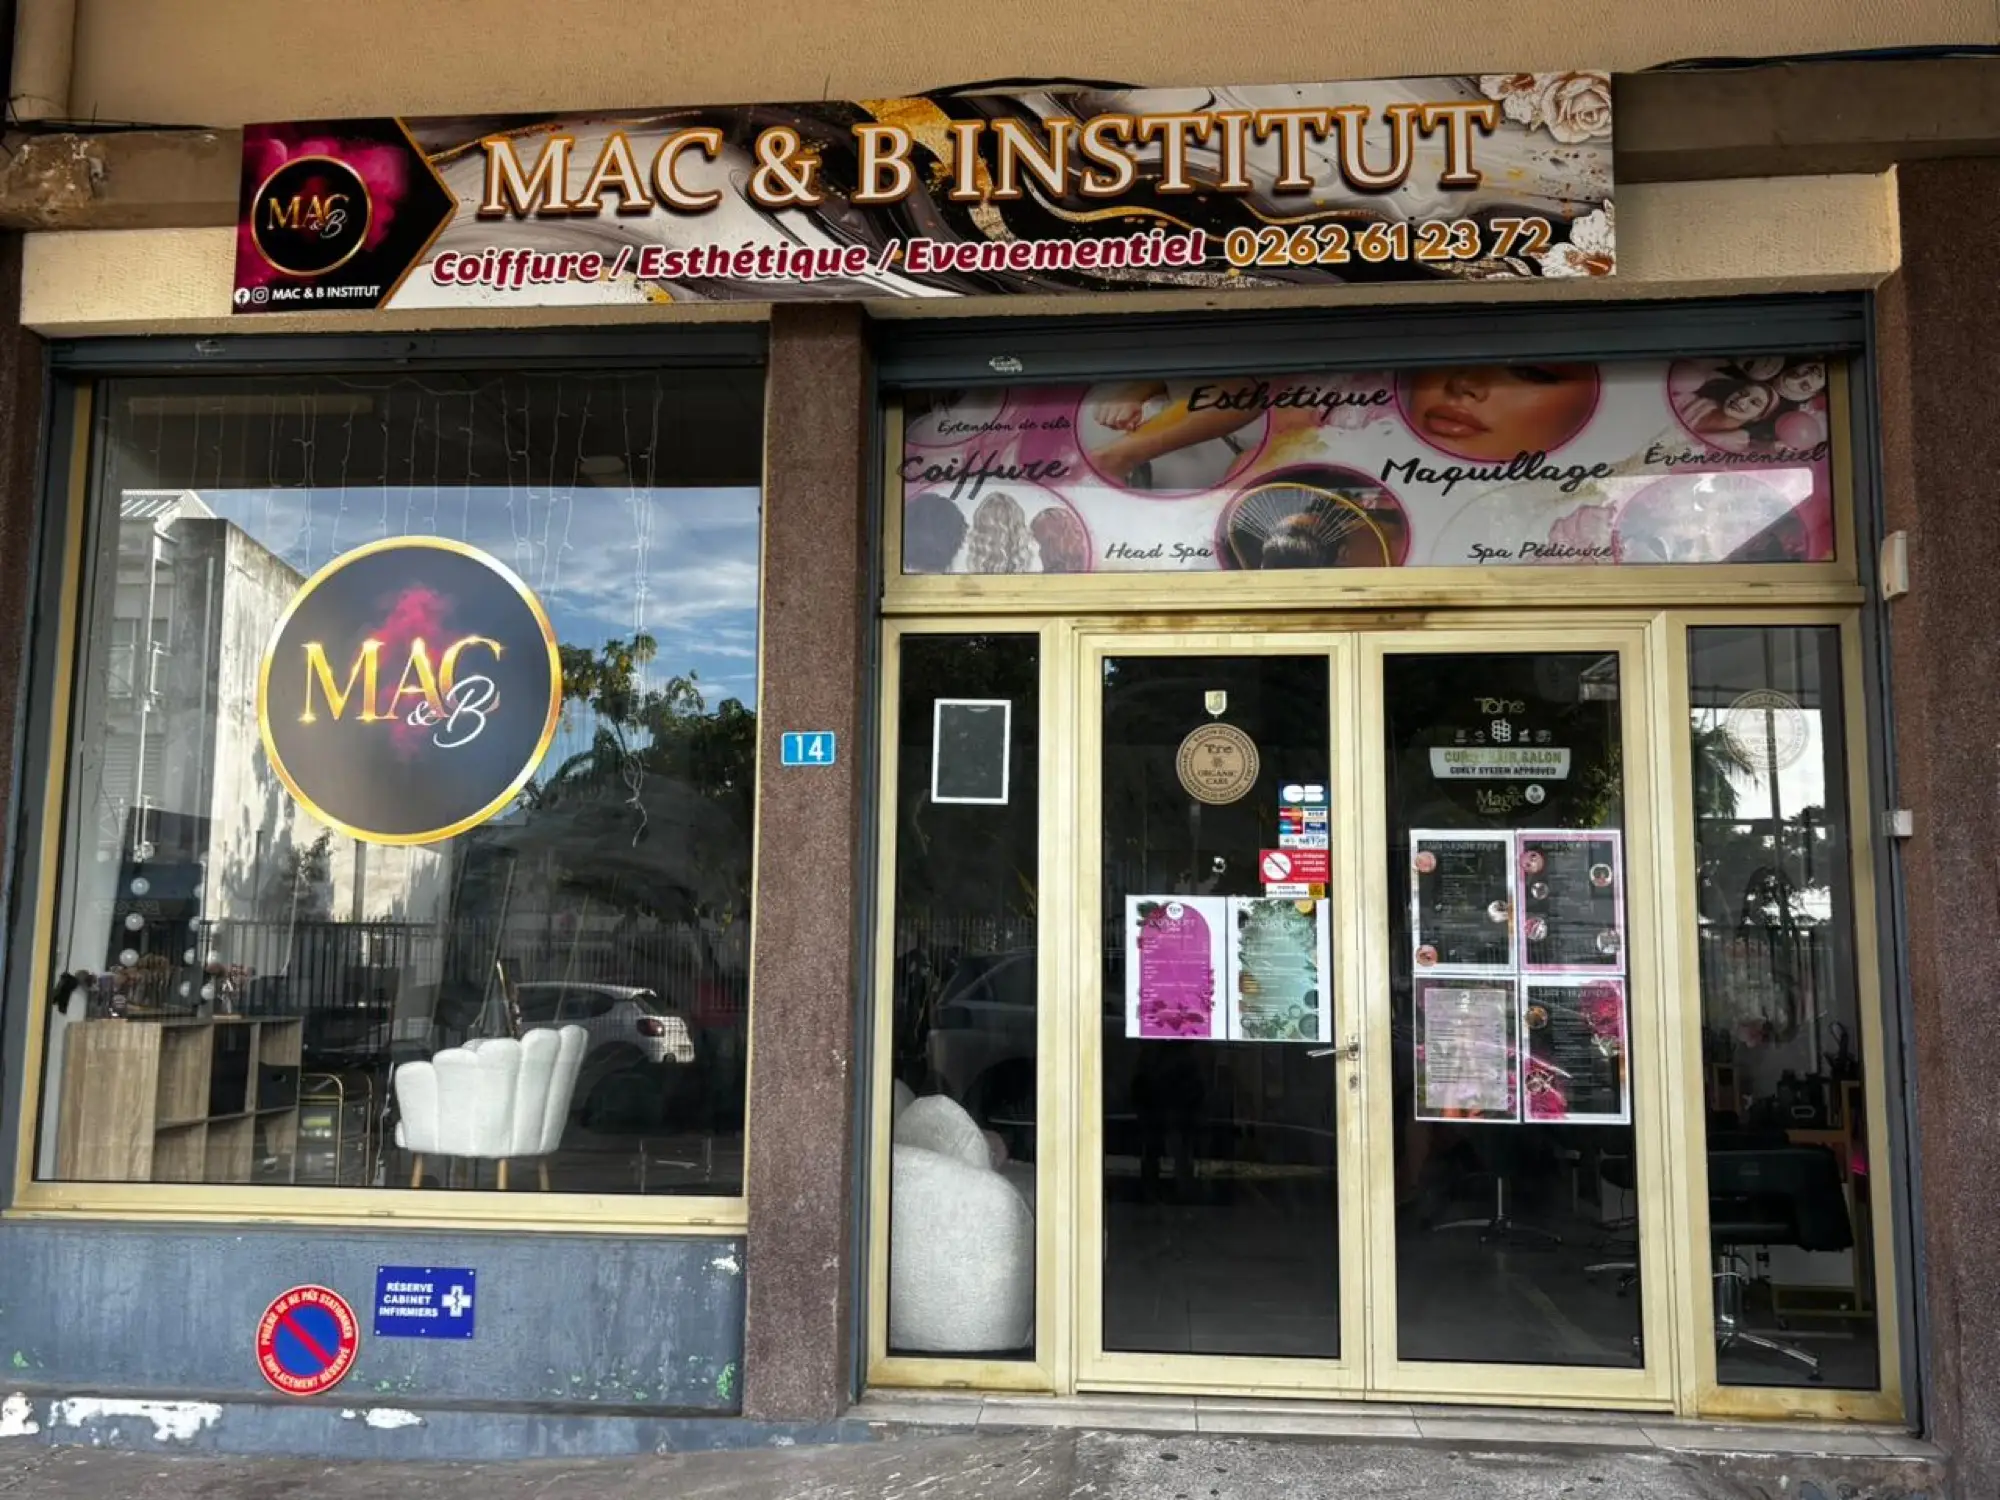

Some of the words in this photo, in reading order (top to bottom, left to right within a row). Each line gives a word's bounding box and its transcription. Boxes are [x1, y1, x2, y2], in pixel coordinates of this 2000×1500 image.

[476, 127, 723, 216] MAC
[750, 125, 821, 209] &
[852, 121, 914, 203] B
[947, 99, 1499, 199] INSTITUT
[267, 194, 349, 230] MAC
[320, 208, 347, 239] B
[433, 245, 600, 290] Coiffure
[638, 239, 866, 286] Esthétique
[905, 228, 1205, 272] Evenementiel
[1225, 223, 1350, 266] 0262
[1358, 223, 1409, 261] 61
[1414, 220, 1480, 259] 23
[1491, 217, 1551, 257] 72
[272, 288, 301, 300] MAC
[303, 288, 314, 299] &
[316, 287, 325, 298] B
[327, 285, 380, 297] INSTITUT
[1188, 384, 1391, 420] Esthétique
[938, 418, 1013, 436] Extension
[1018, 417, 1038, 432] de
[1042, 417, 1071, 431] cils
[897, 451, 1072, 499] Coiffure
[1381, 450, 1614, 496] Maquillage
[1106, 542, 1166, 559] Head
[1168, 542, 1213, 562] Spa
[1468, 543, 1512, 563] Spa
[1518, 541, 1614, 559] Pédicure
[298, 635, 506, 725] MAC
[407, 699, 440, 726] &
[433, 675, 496, 748] B
[795, 735, 825, 761] 14
[379, 1307, 439, 1318] INFIRMIERS
[383, 1294, 432, 1305] CABINET
